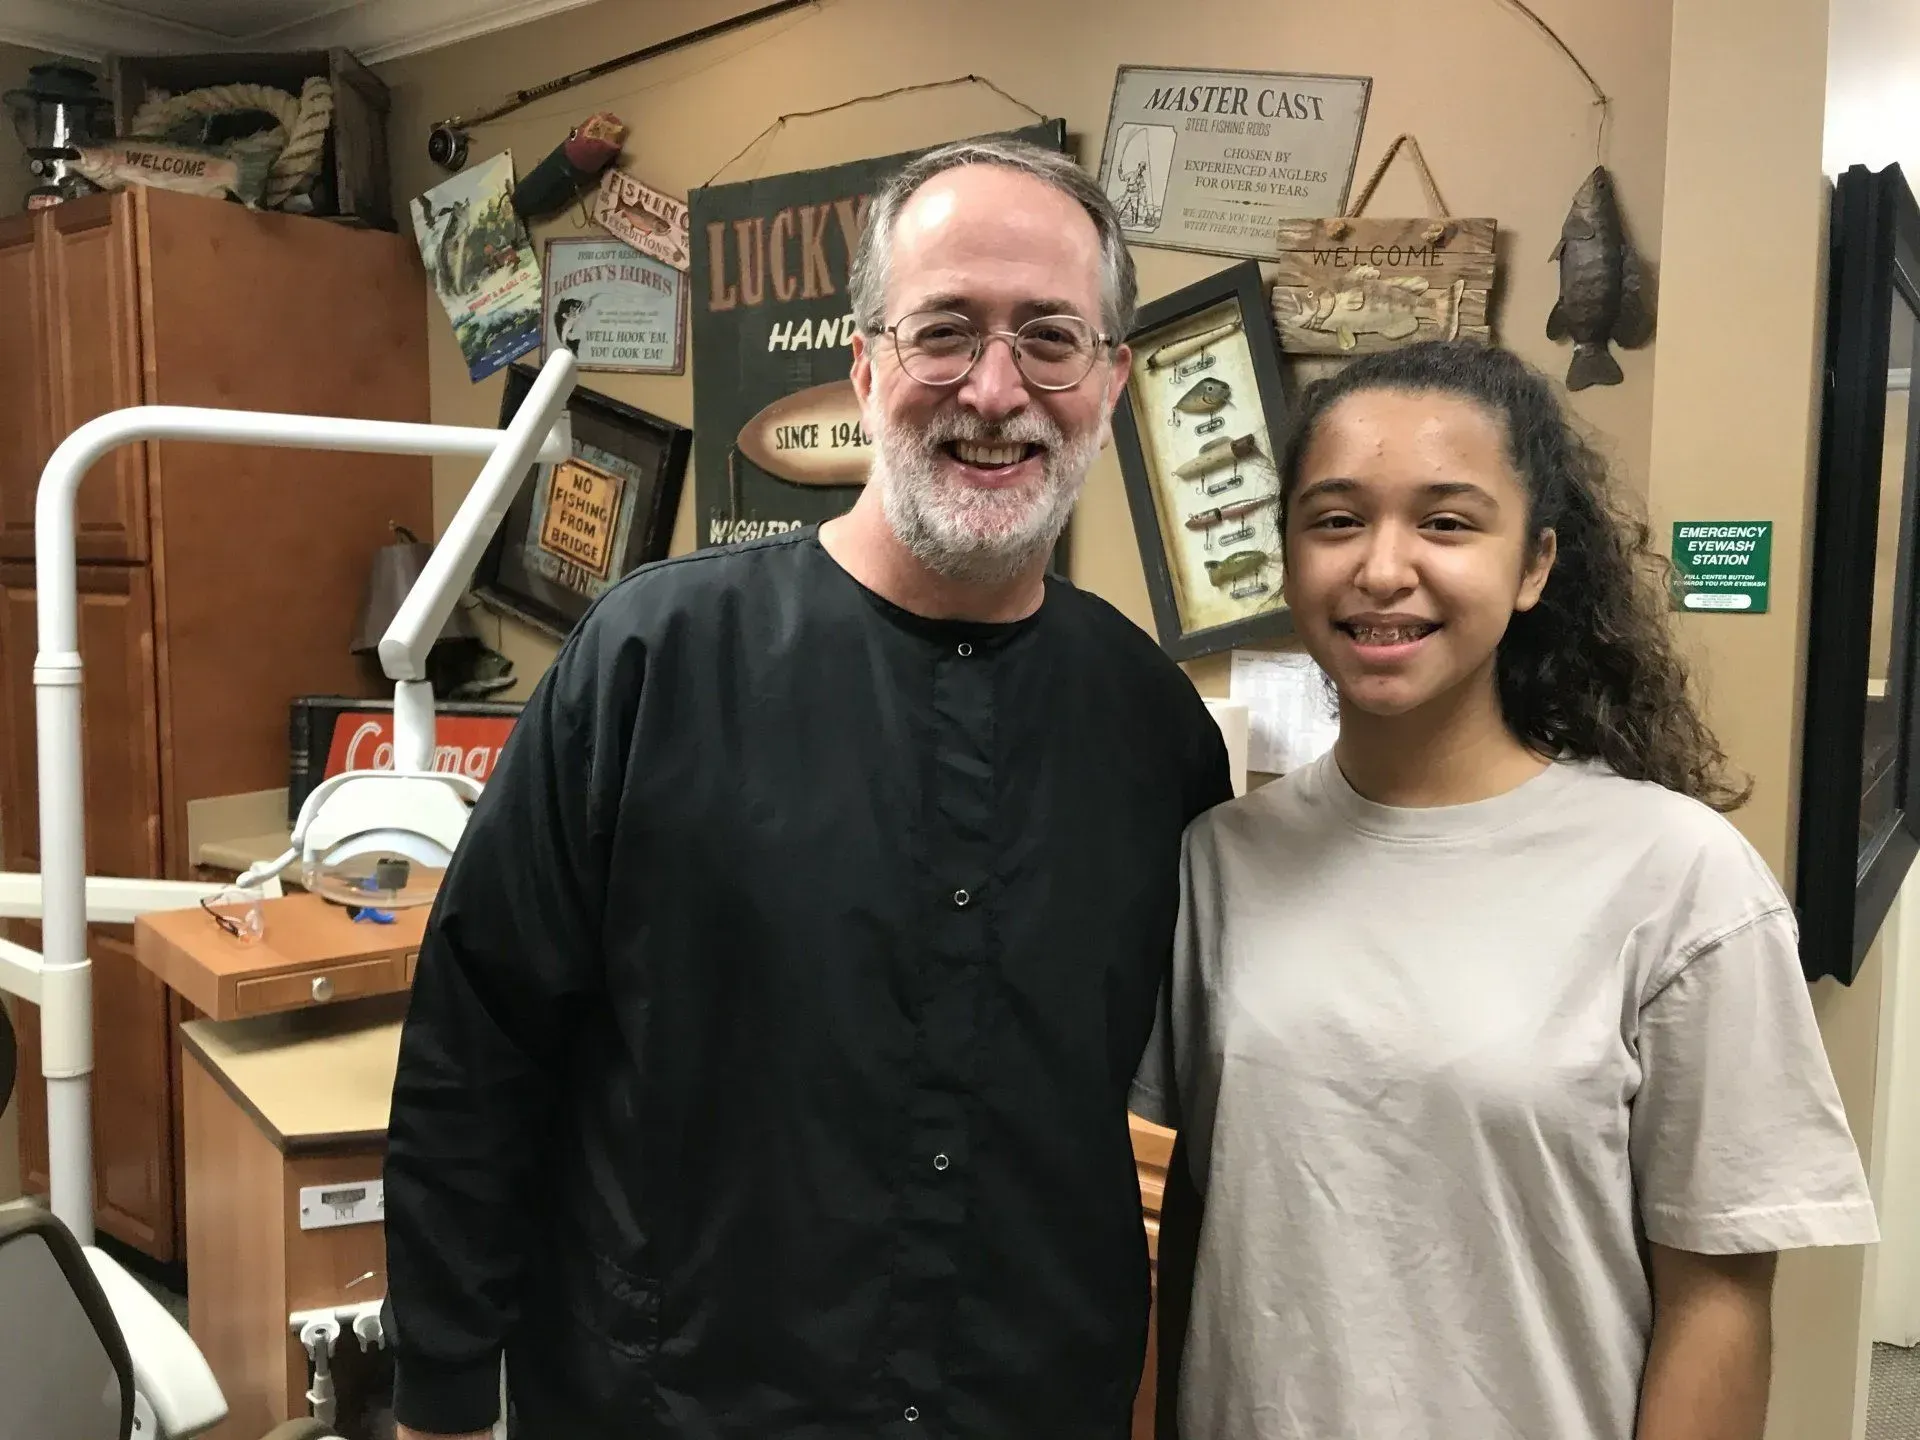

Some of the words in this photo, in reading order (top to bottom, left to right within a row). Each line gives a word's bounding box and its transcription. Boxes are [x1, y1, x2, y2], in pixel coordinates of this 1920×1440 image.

[1143, 86, 1249, 116] MASTER
[1257, 89, 1325, 121] CAST
[1185, 117, 1209, 132] STEEL
[1211, 119, 1245, 135] FISHING
[1246, 121, 1272, 137] RODS
[125, 150, 207, 177] WELCOME
[1223, 147, 1272, 162] CHOSEN
[1274, 152, 1292, 163] BY
[1184, 160, 1267, 177] EXPERIENCED
[1268, 167, 1328, 183] ANGLERS
[1195, 176, 1219, 189] FOR
[1220, 178, 1252, 192] OVER
[1254, 182, 1268, 192] 50
[1269, 183, 1309, 197] YEARS
[1313, 245, 1445, 267] WELCOME
[553, 264, 617, 296] LUCKY'S
[620, 265, 673, 297] LURES
[586, 330, 614, 343] WE'LL
[616, 331, 647, 343] HOOK
[590, 346, 609, 358] YOU
[612, 347, 641, 359] COOK
[776, 424, 819, 450] SINCE
[572, 473, 593, 495] NO
[555, 487, 608, 523] FISHING
[559, 510, 597, 537] FROM
[1679, 526, 1767, 538] EMERGENCY
[551, 528, 598, 561] BRIDGE
[1688, 541, 1756, 552] EYEWASH
[1692, 554, 1750, 565] STATION
[557, 560, 590, 593] FUN
